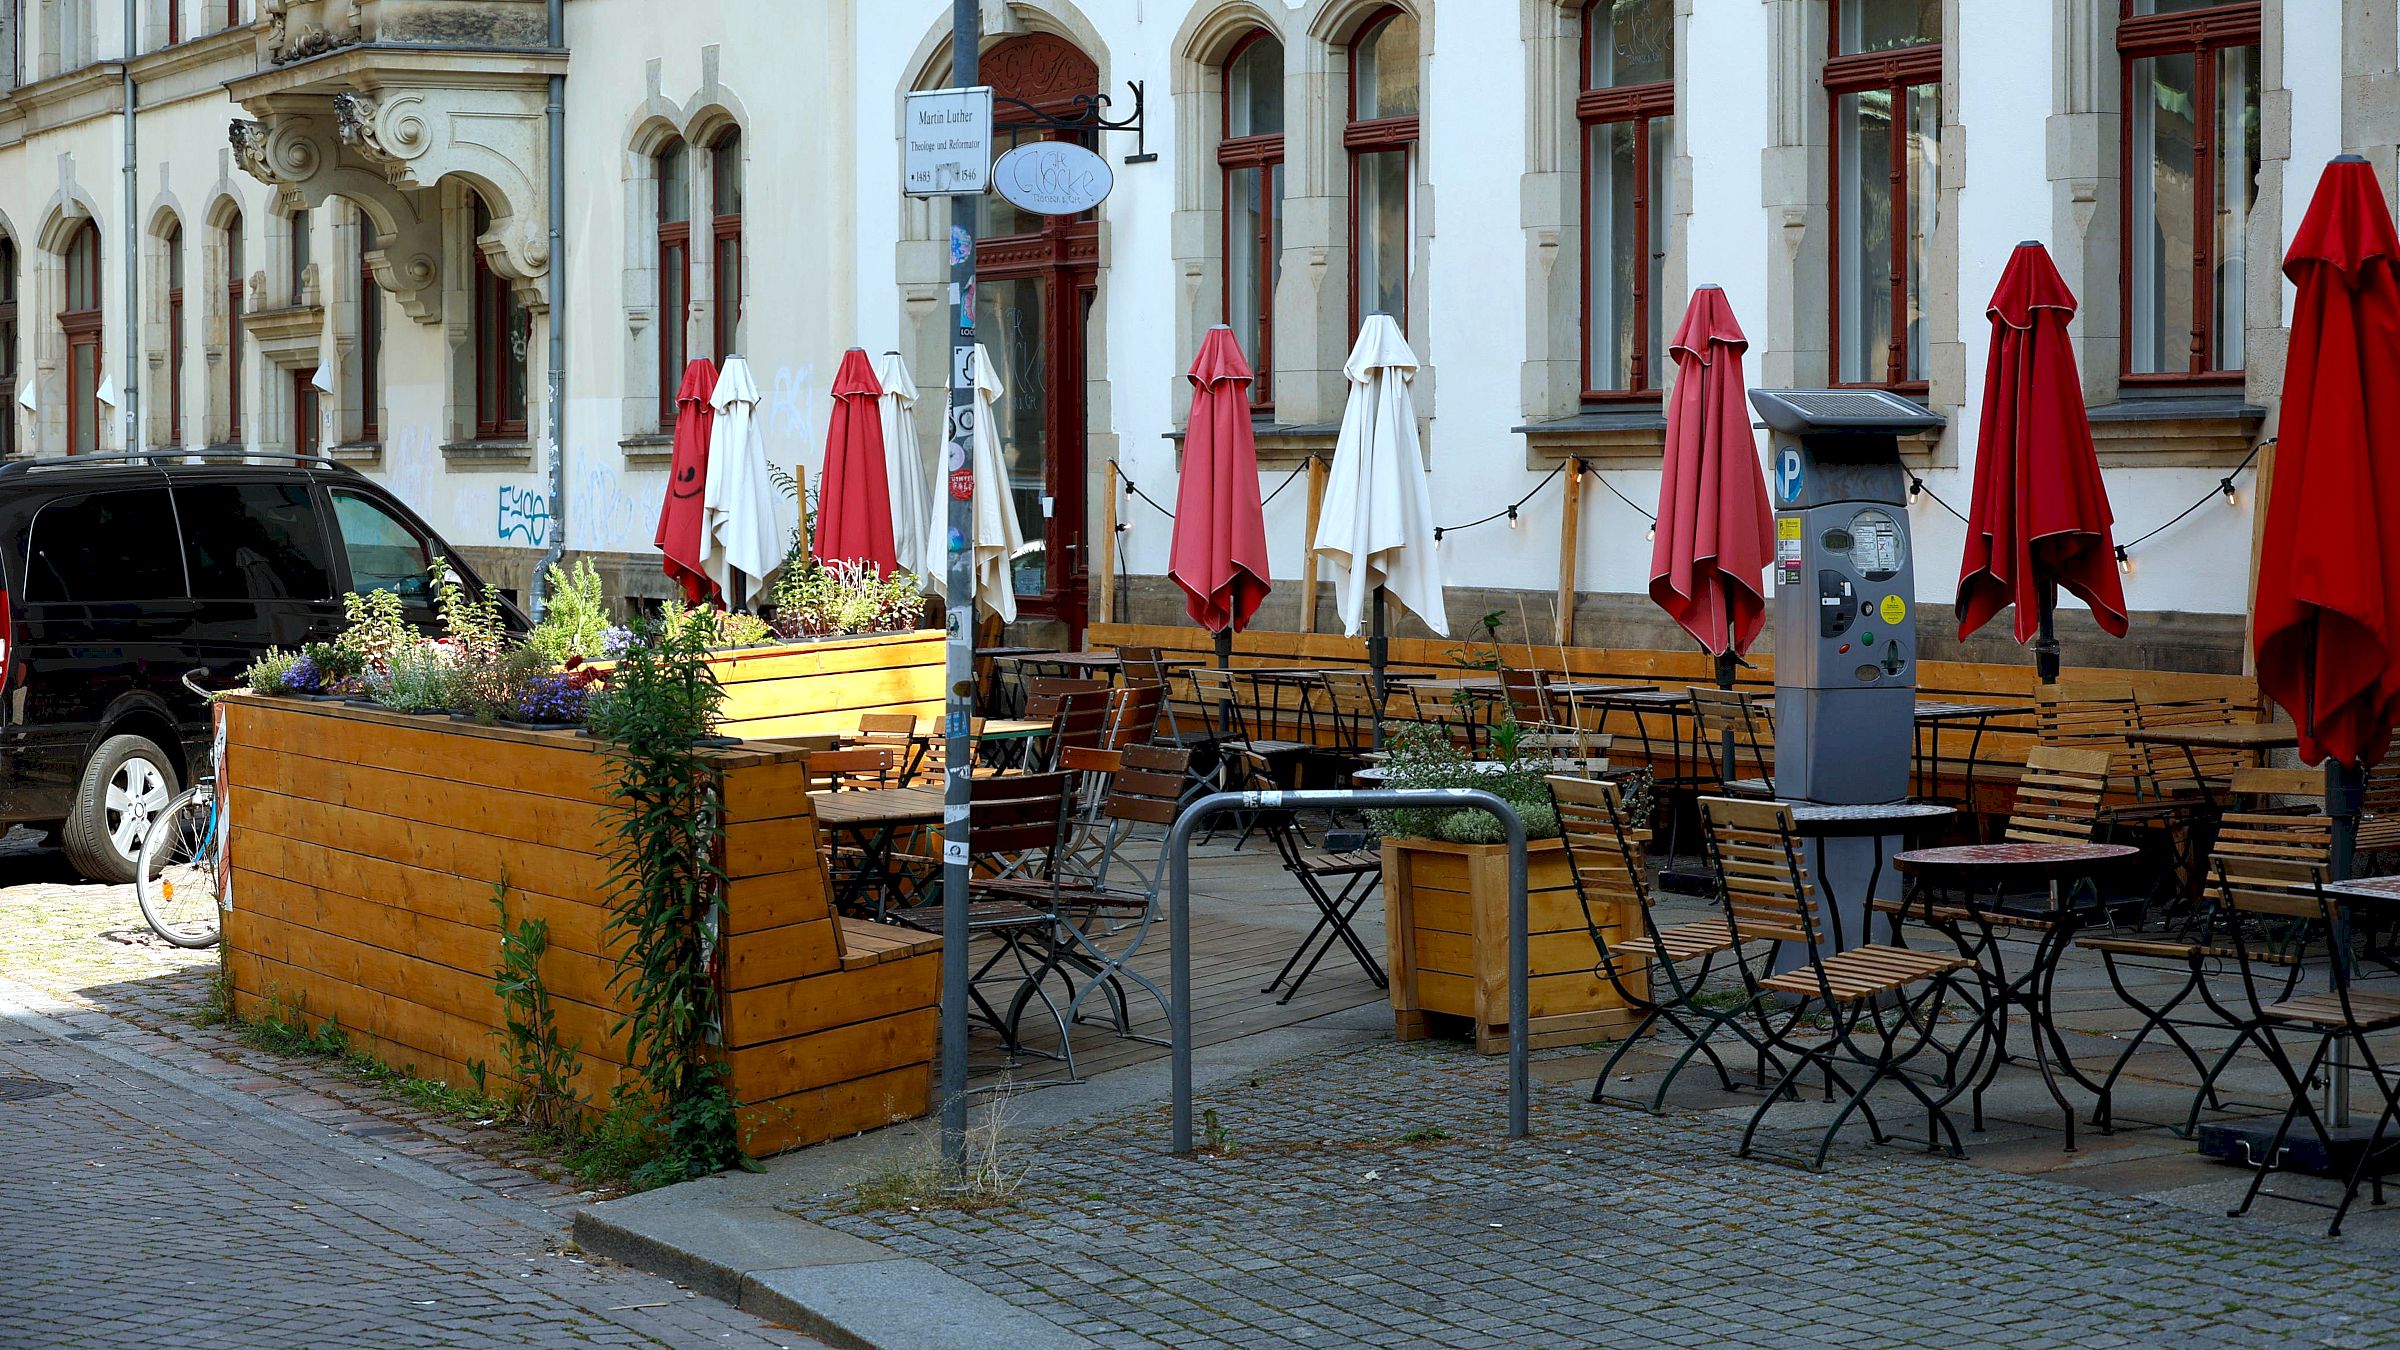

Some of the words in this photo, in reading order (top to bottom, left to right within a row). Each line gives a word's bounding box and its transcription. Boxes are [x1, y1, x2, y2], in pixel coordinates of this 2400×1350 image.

[919, 110, 944, 125] Martin
[947, 108, 973, 124] Luther
[911, 140, 935, 152] Theologe
[937, 139, 947, 150] und
[949, 138, 981, 150] Reformator
[917, 170, 931, 183] 1483
[961, 168, 977, 181] 1546
[1784, 450, 1801, 499] P
